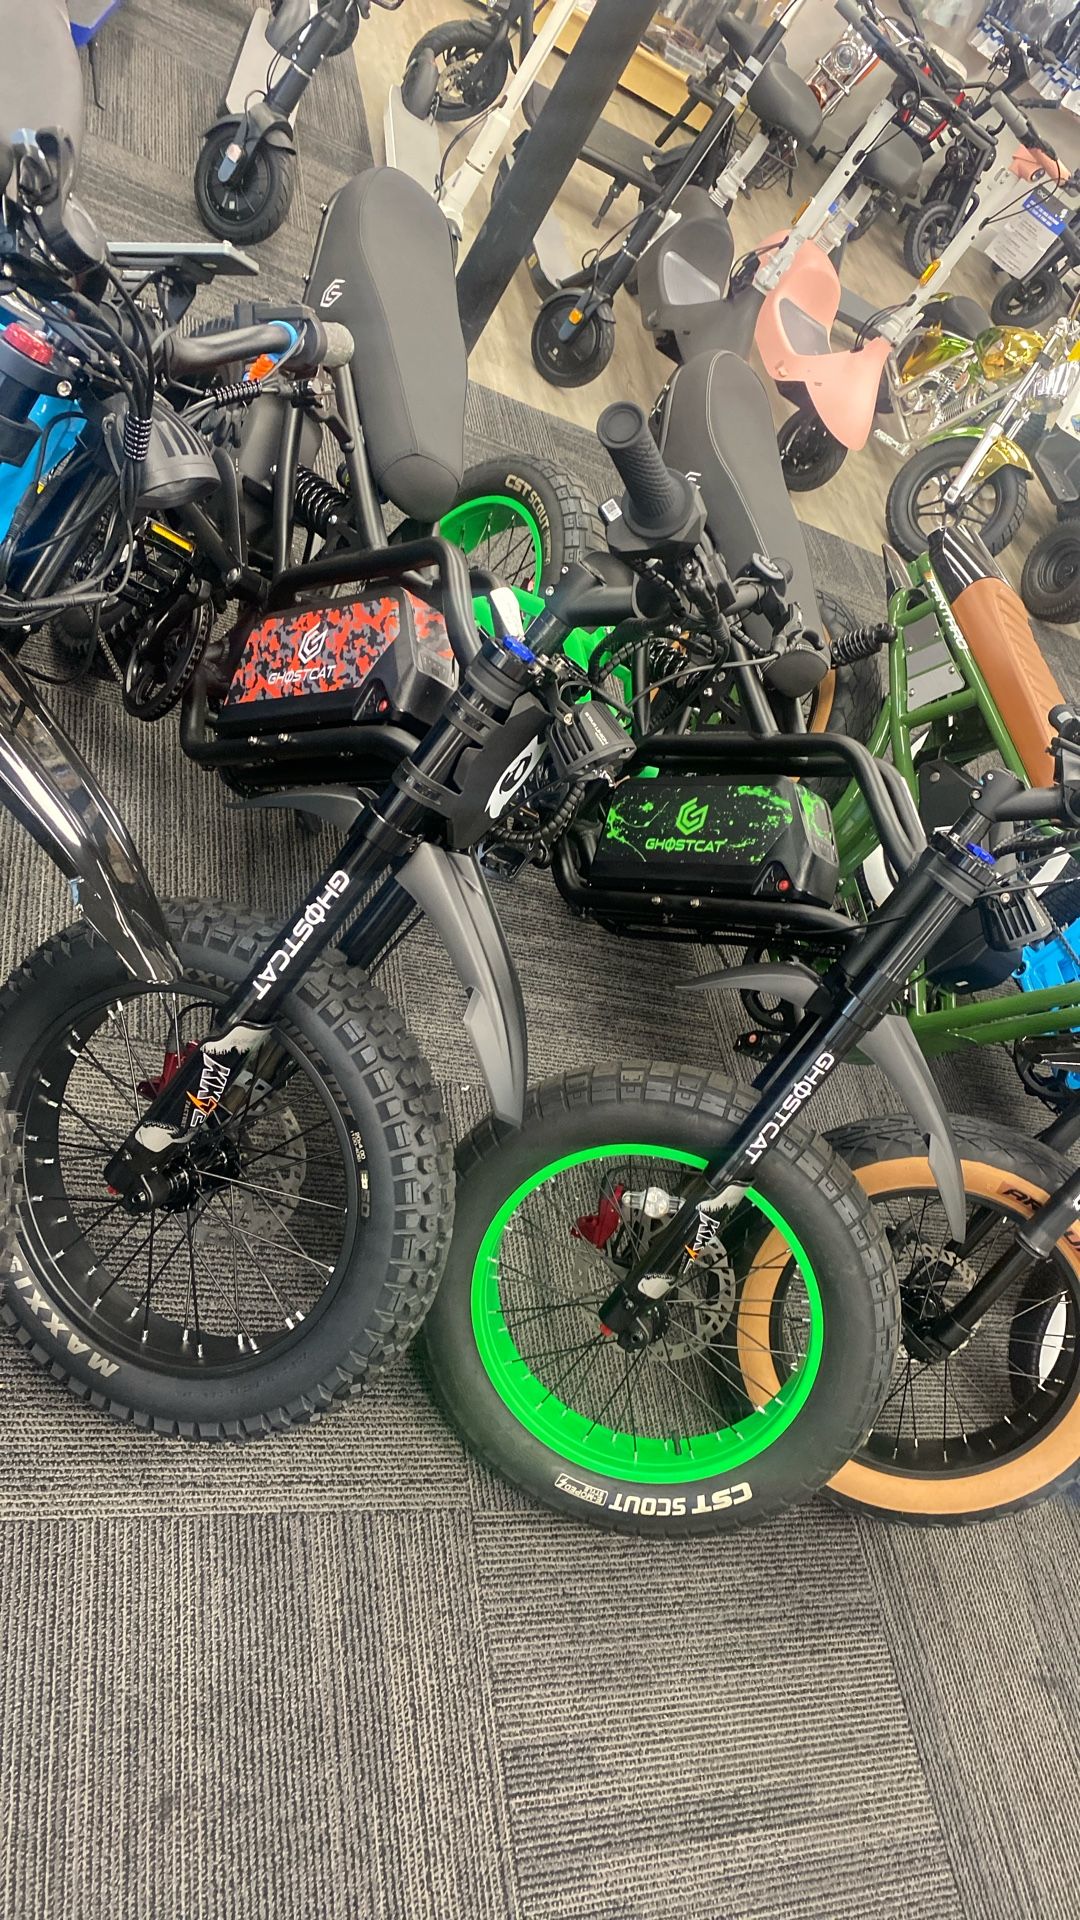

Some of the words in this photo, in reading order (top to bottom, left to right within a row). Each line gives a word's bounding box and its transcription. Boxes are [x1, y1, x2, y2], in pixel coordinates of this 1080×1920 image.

[504, 474, 532, 497] CST
[527, 490, 550, 530] SCOUT
[608, 1493, 687, 1517] SCOUT
[692, 1481, 753, 1515] CST
